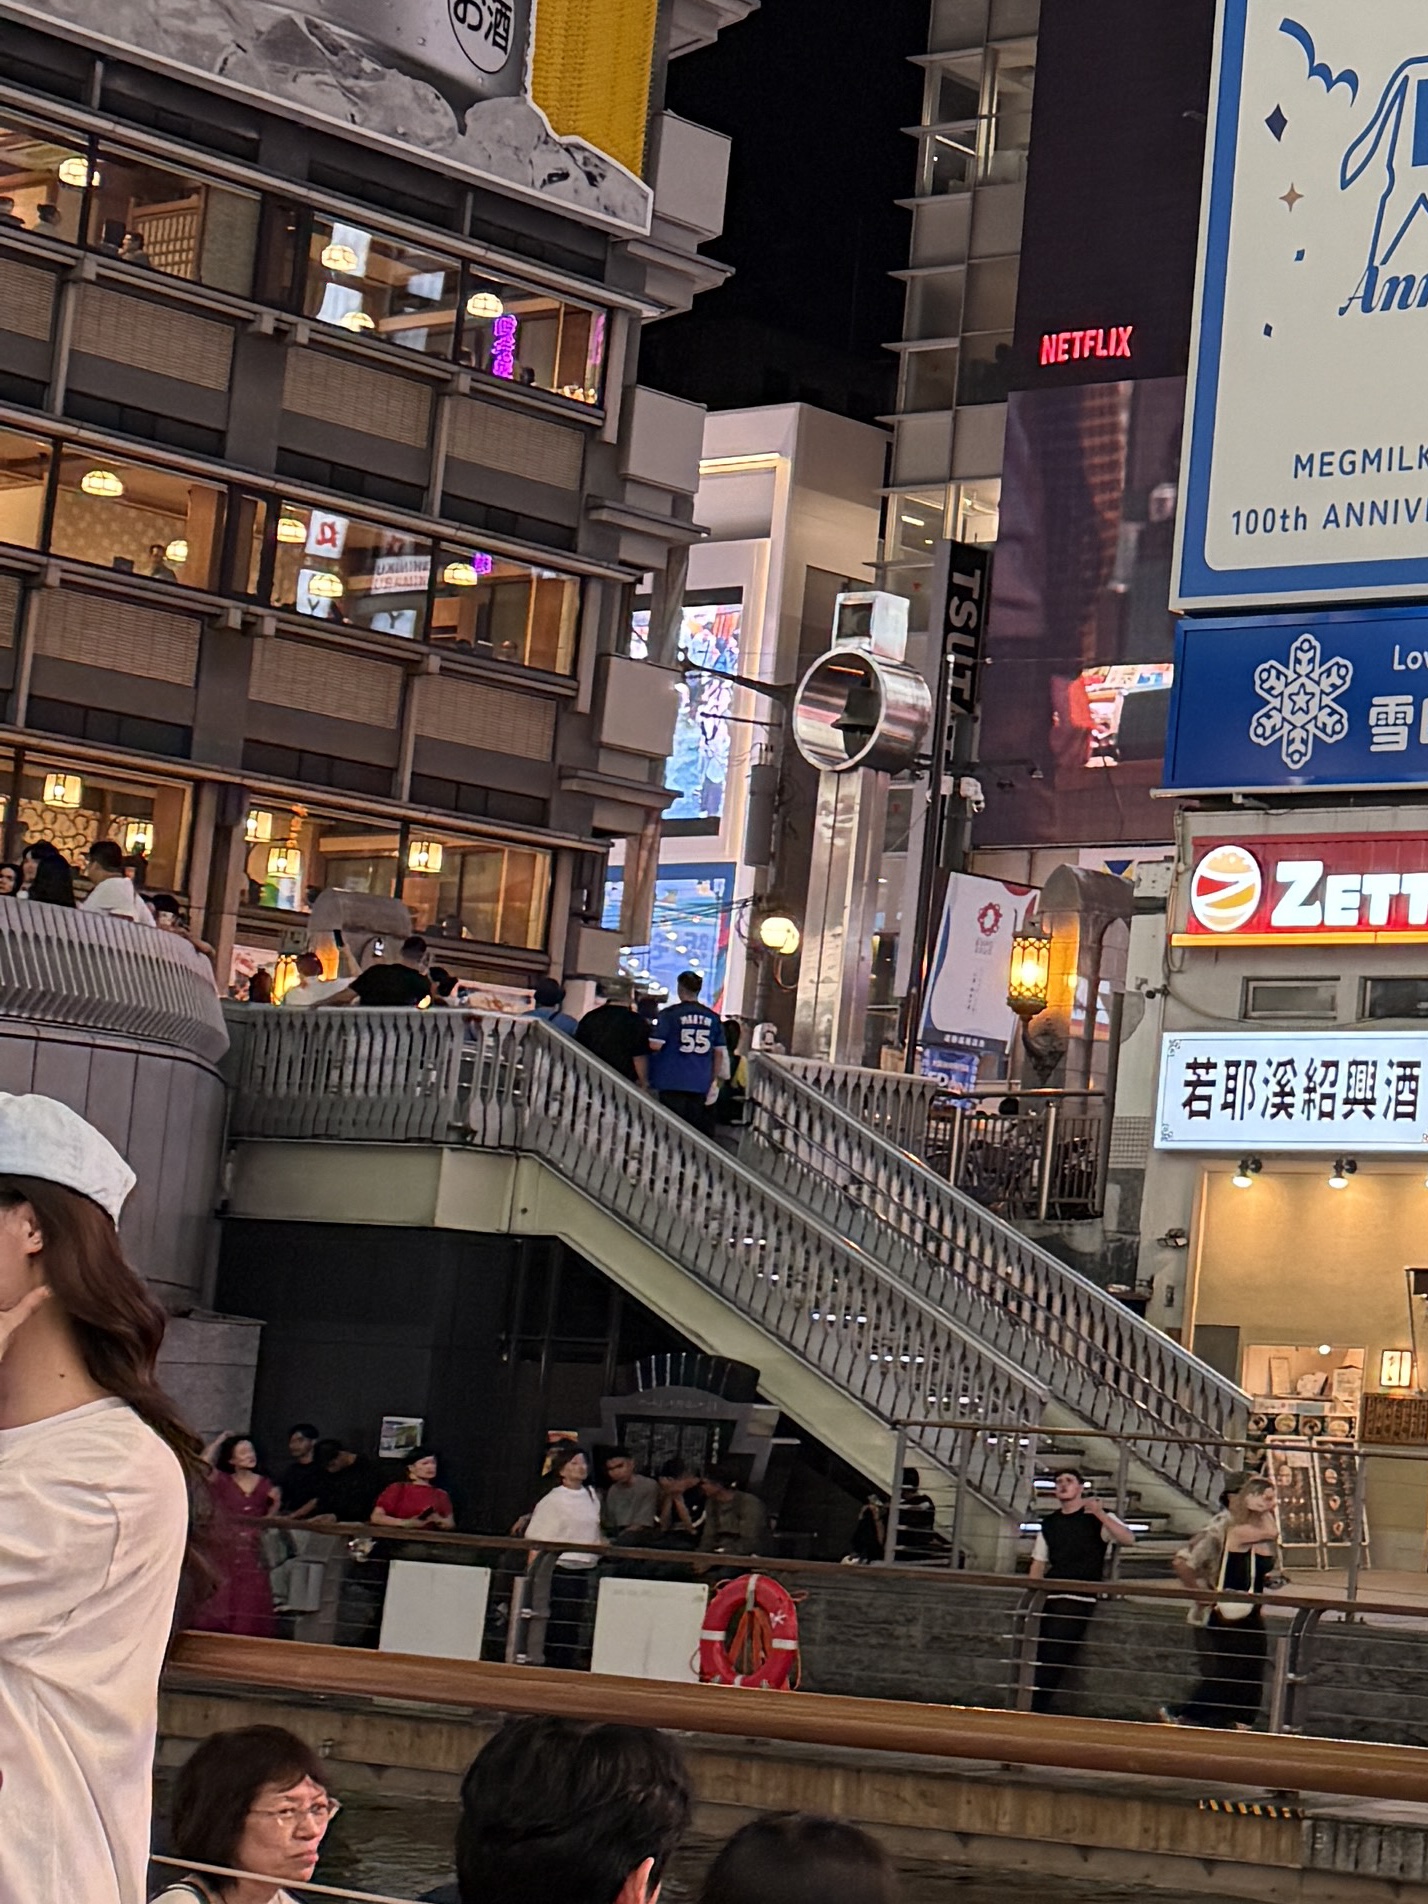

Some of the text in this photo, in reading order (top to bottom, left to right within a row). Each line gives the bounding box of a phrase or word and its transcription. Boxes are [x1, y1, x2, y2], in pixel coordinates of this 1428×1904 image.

[1040, 325, 1134, 365] NETFLIX
[1231, 502, 1309, 538] 100th
[946, 568, 982, 718] TSUT
[679, 1028, 711, 1055] 55
